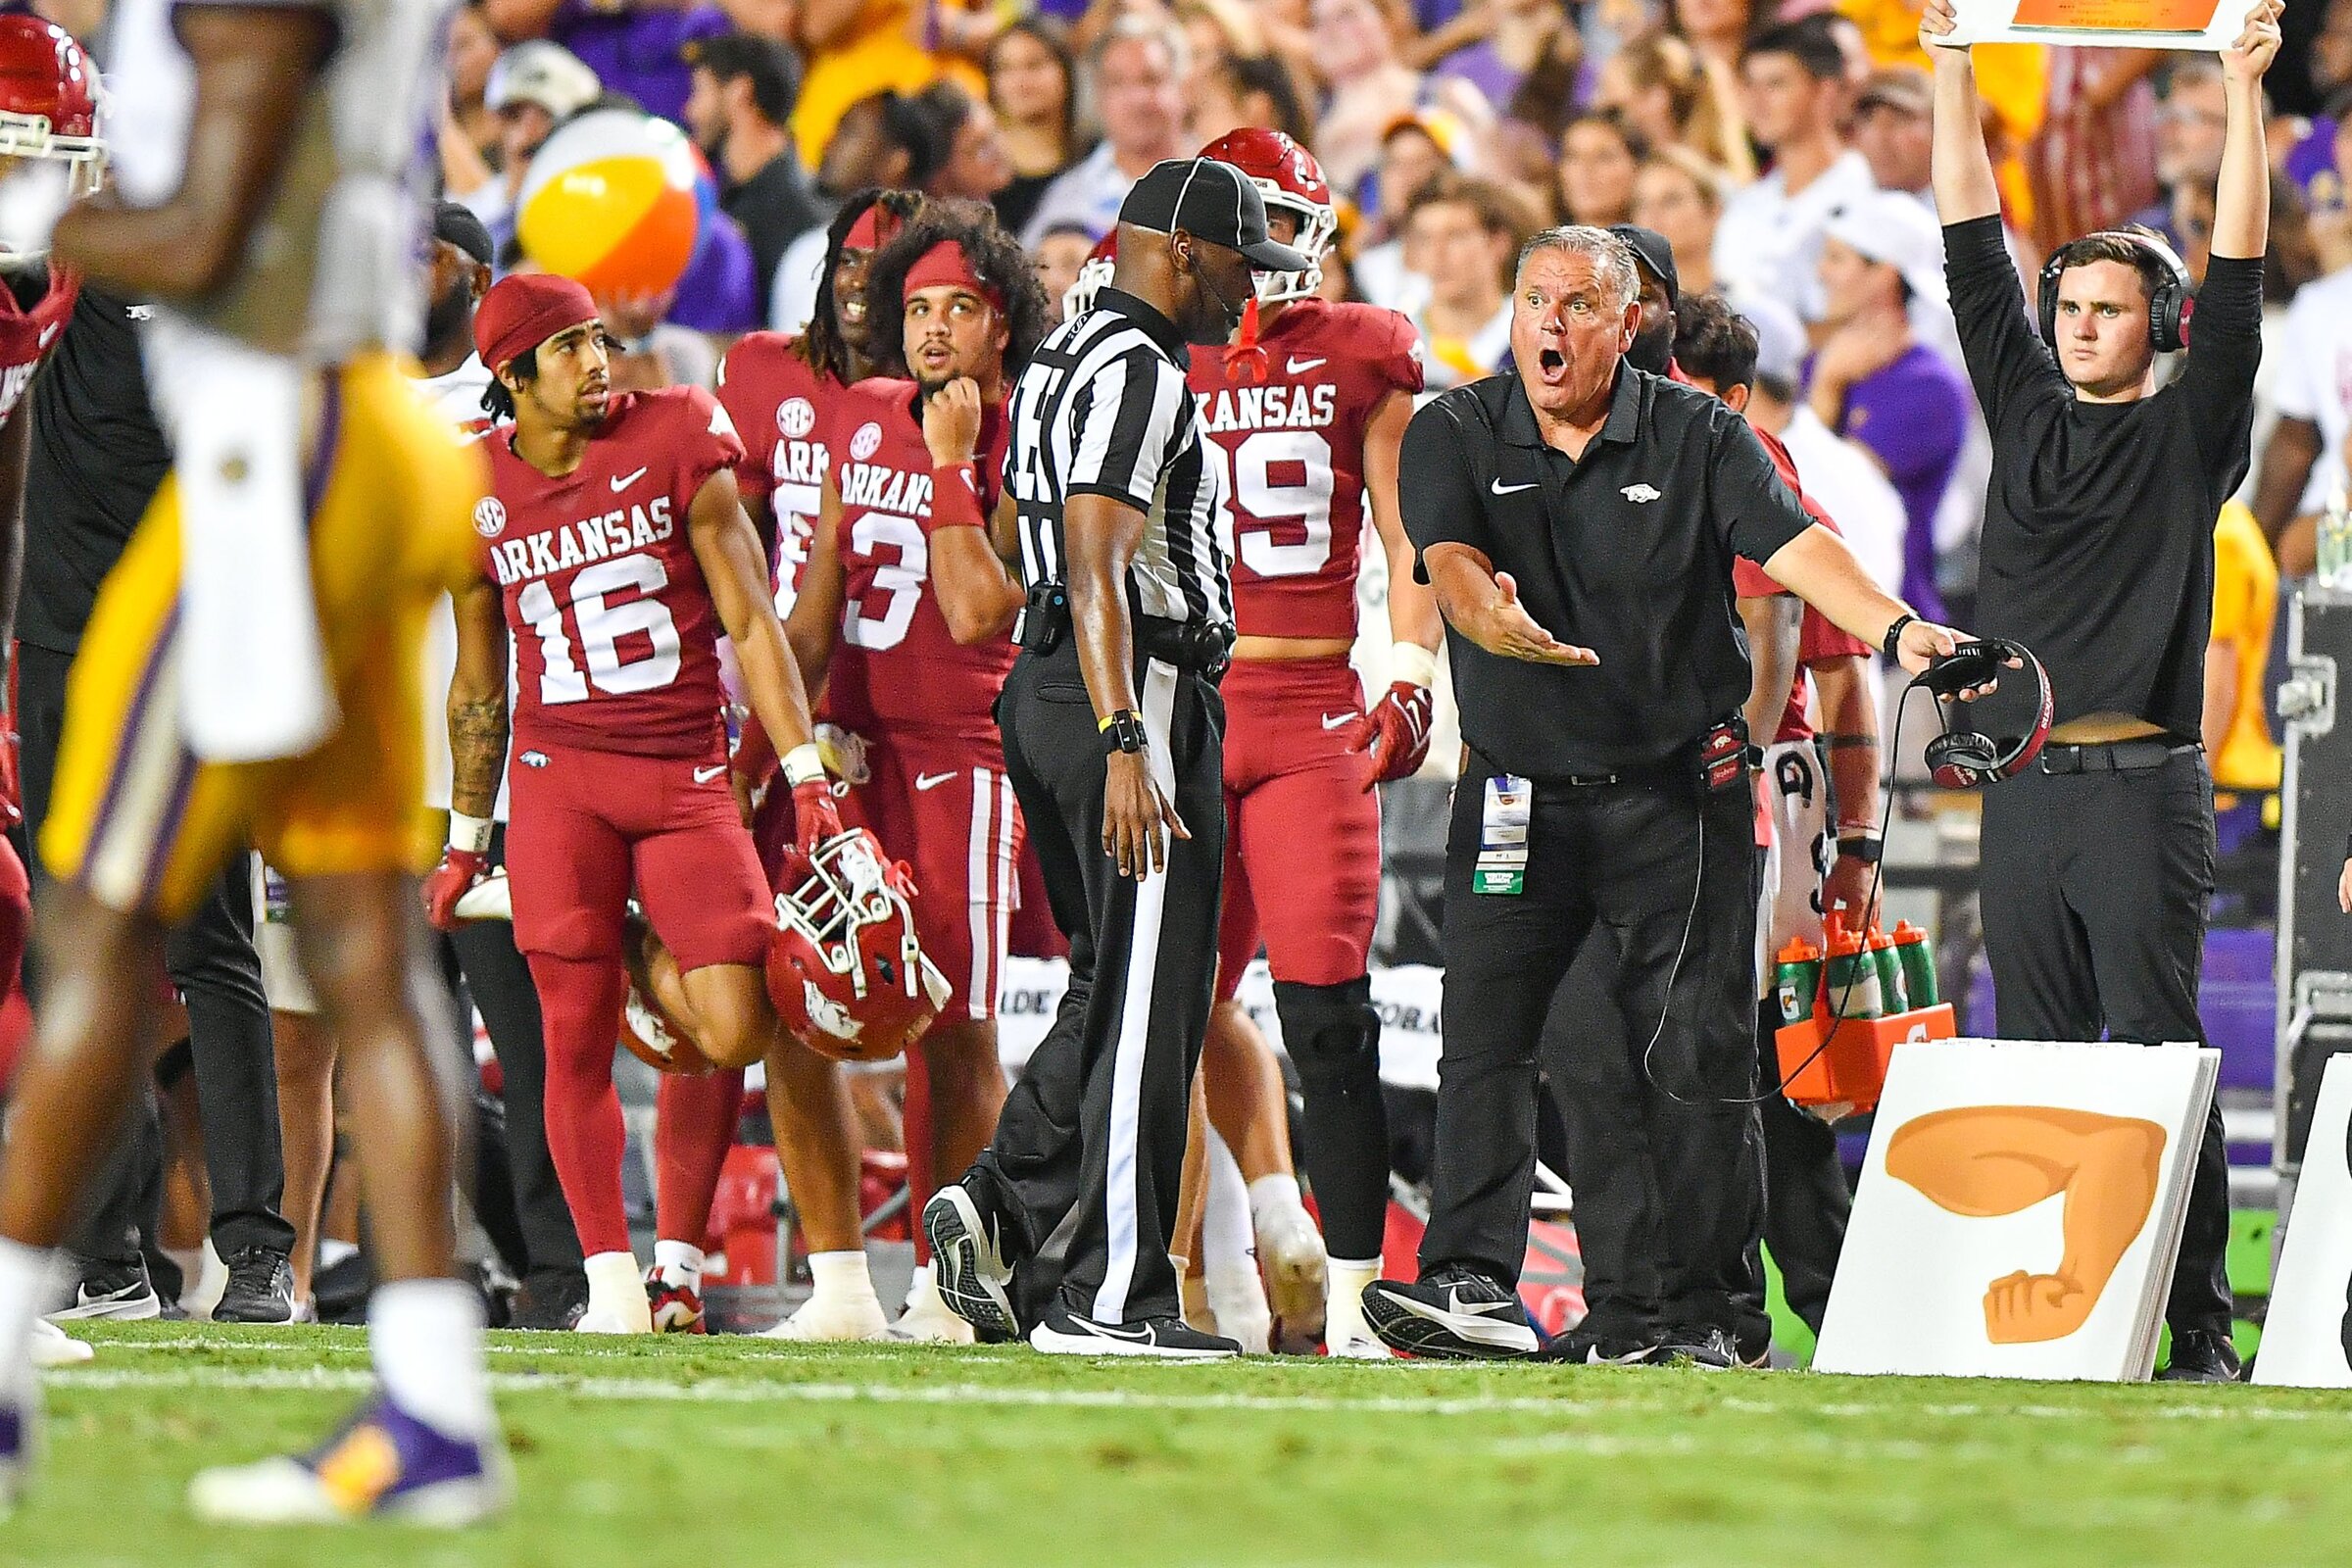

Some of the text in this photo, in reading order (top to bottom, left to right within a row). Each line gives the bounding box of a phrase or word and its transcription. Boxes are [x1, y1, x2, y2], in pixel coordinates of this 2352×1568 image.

[781, 398, 811, 435] SEC
[474, 506, 506, 535] SEC
[489, 496, 674, 586] ARKANSAS
[842, 511, 929, 652] 3
[516, 552, 683, 706] 16
